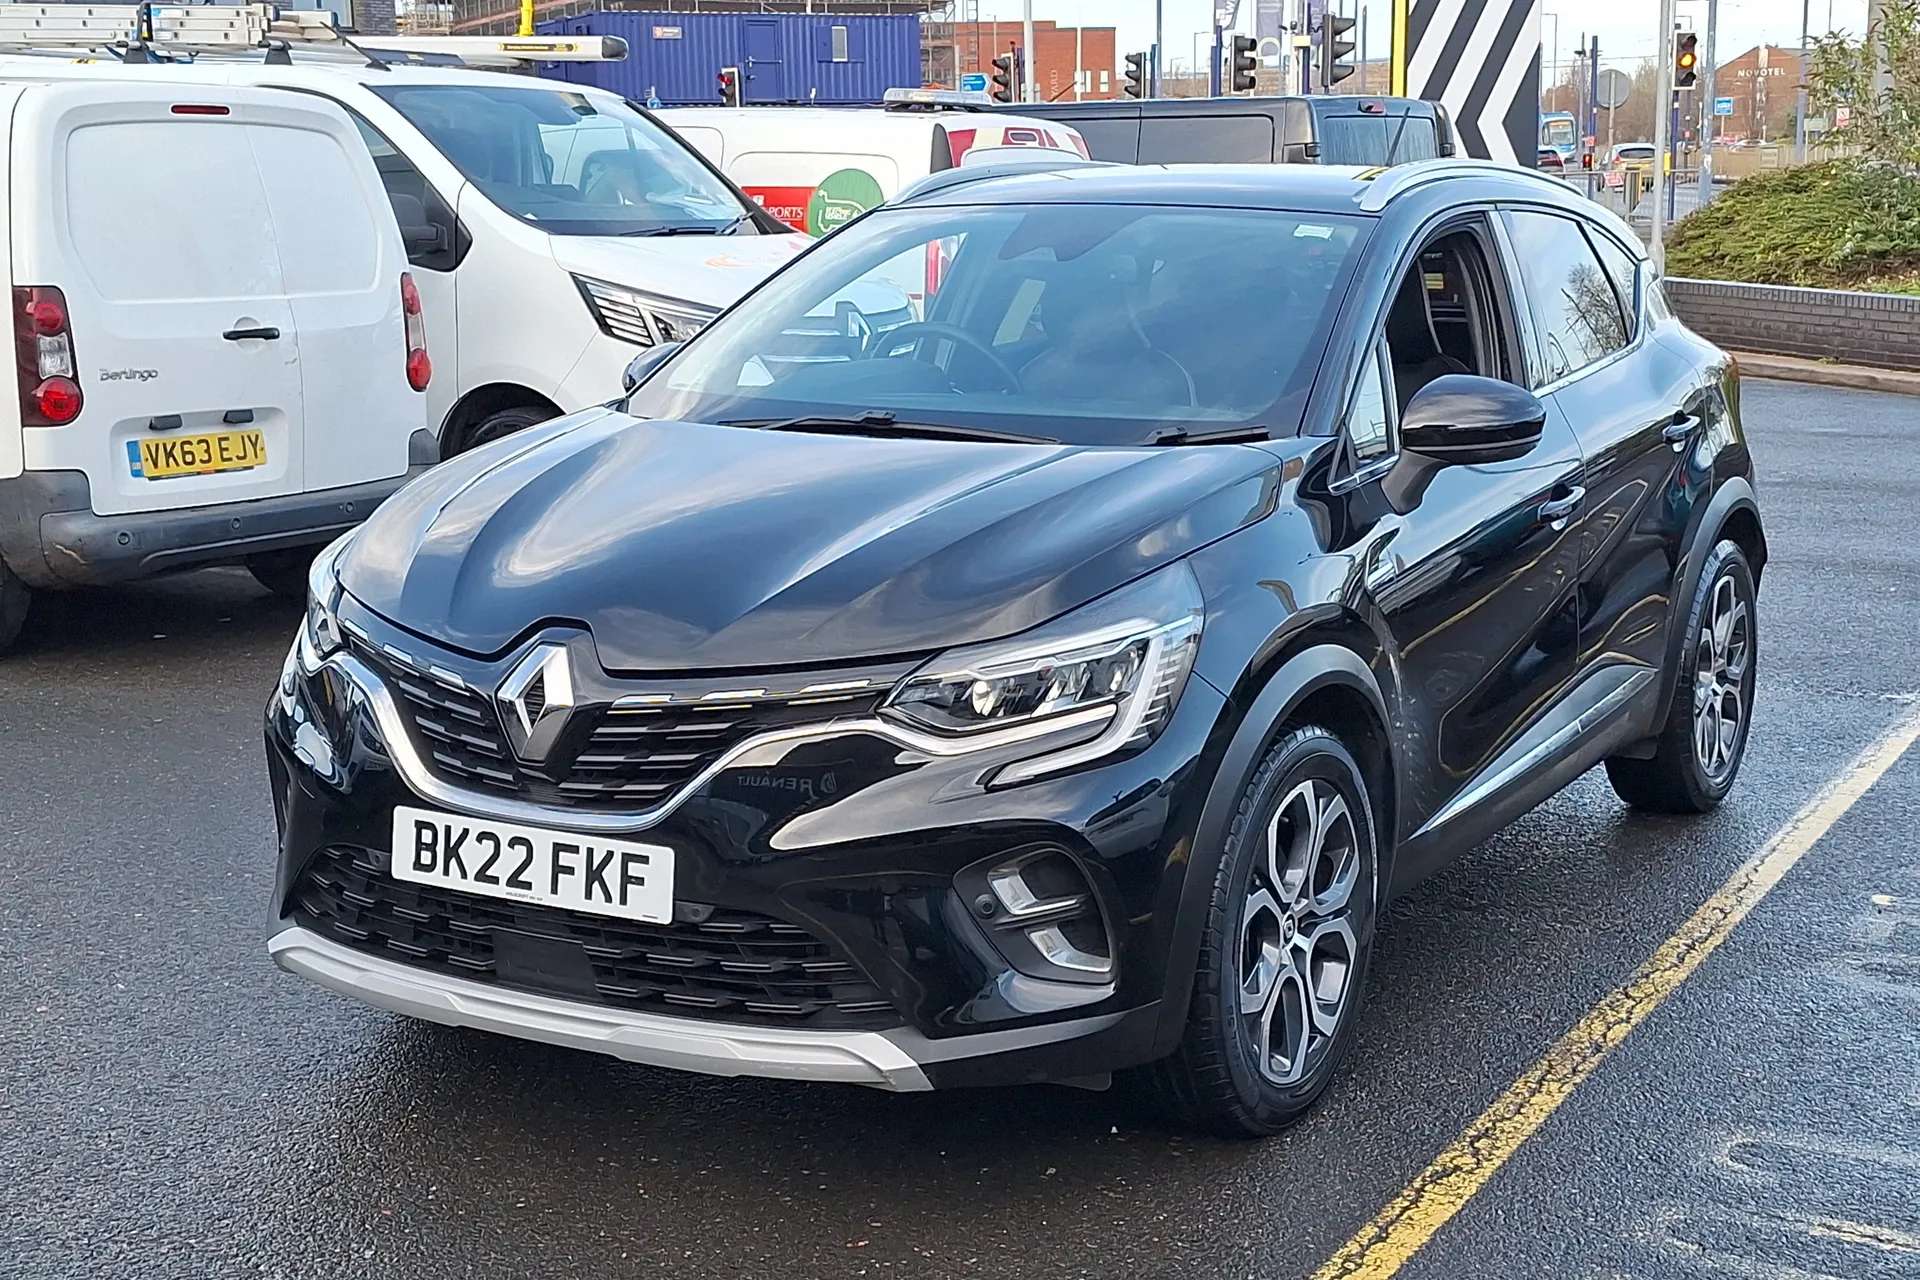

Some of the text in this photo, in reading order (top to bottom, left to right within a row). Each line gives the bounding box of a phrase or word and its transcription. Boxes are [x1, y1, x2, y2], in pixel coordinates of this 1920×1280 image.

[1737, 67, 1785, 77] NOVOTEL
[100, 368, 158, 382] Berlingo
[145, 433, 260, 469] VK63 EJY
[412, 819, 650, 906] BK22 FKF
